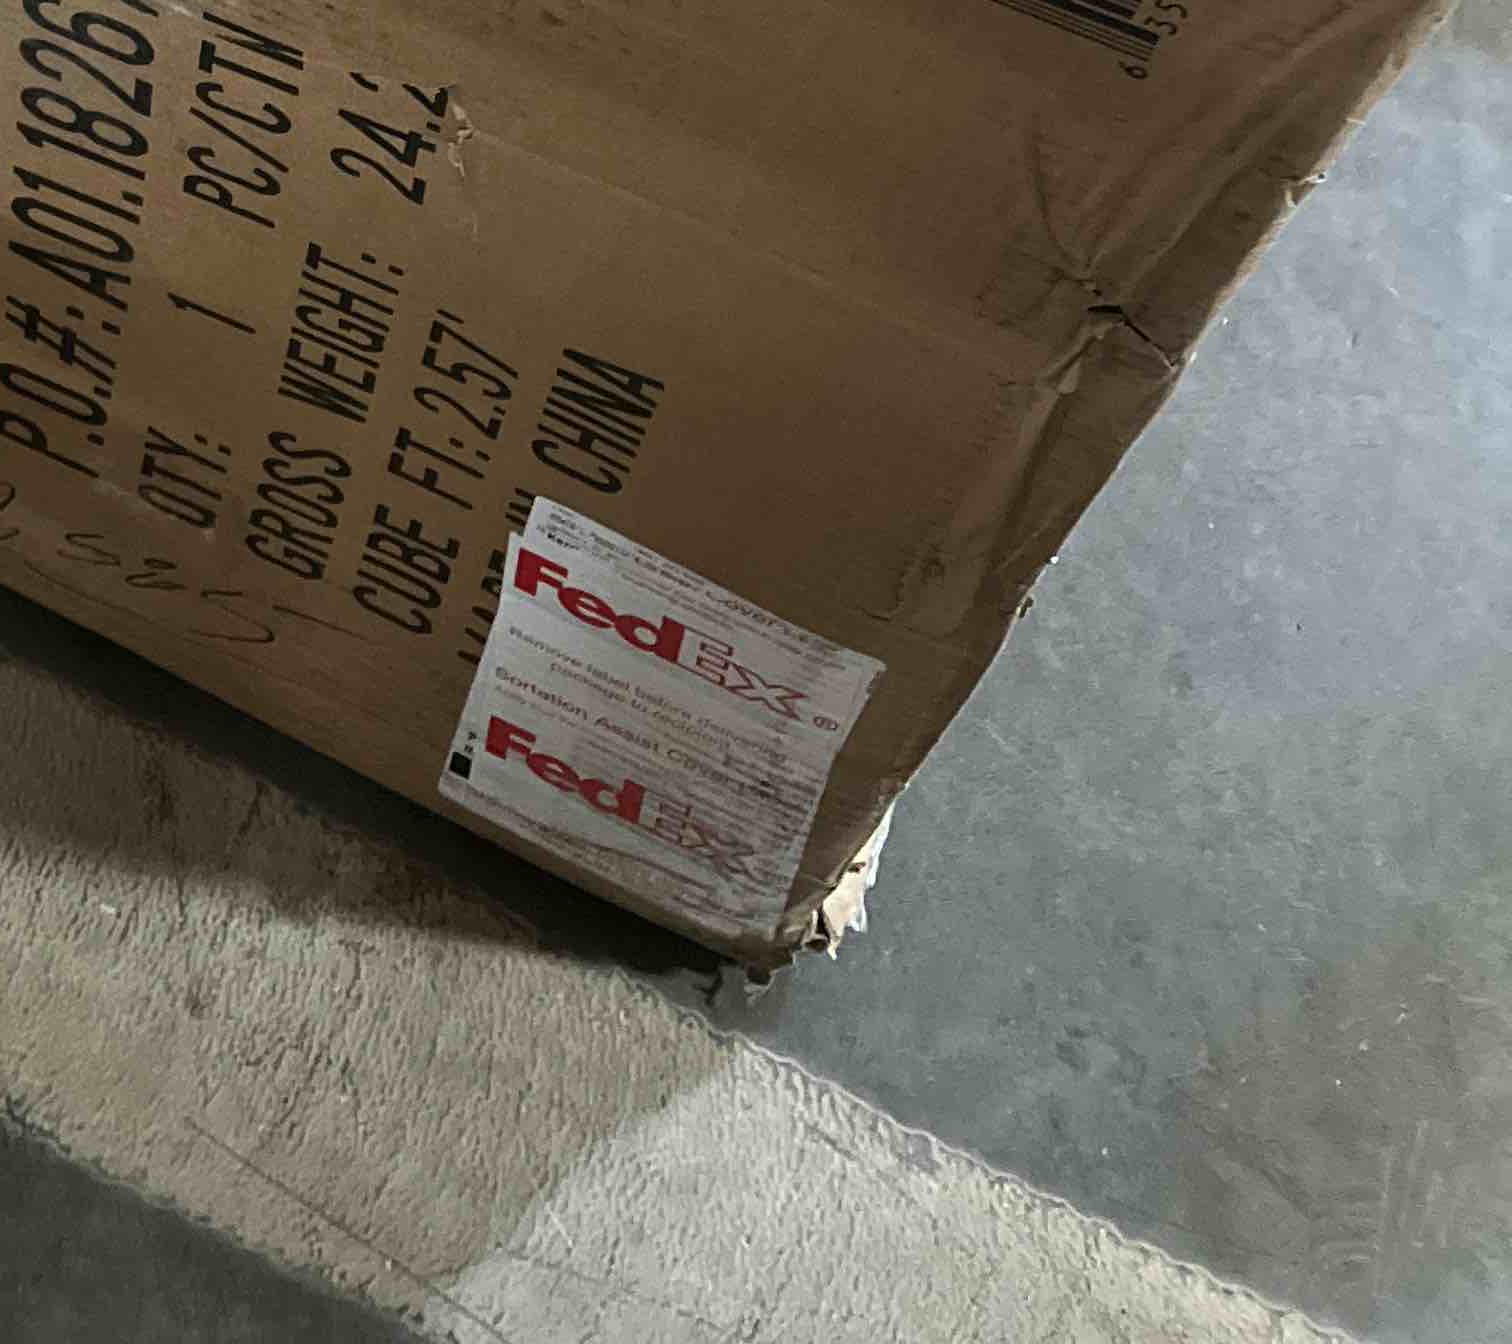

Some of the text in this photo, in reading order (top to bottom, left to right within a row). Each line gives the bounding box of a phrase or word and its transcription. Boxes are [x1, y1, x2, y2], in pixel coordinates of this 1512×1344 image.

[138, 11, 305, 530] QTY: 1 PC/CTN
[280, 242, 406, 422] WEIGHT:
[531, 347, 665, 495] CHINA
[245, 430, 353, 580] GROSS
[351, 502, 461, 634] CUBE
[514, 546, 808, 723] FedEx
[485, 714, 763, 879] FedEx
